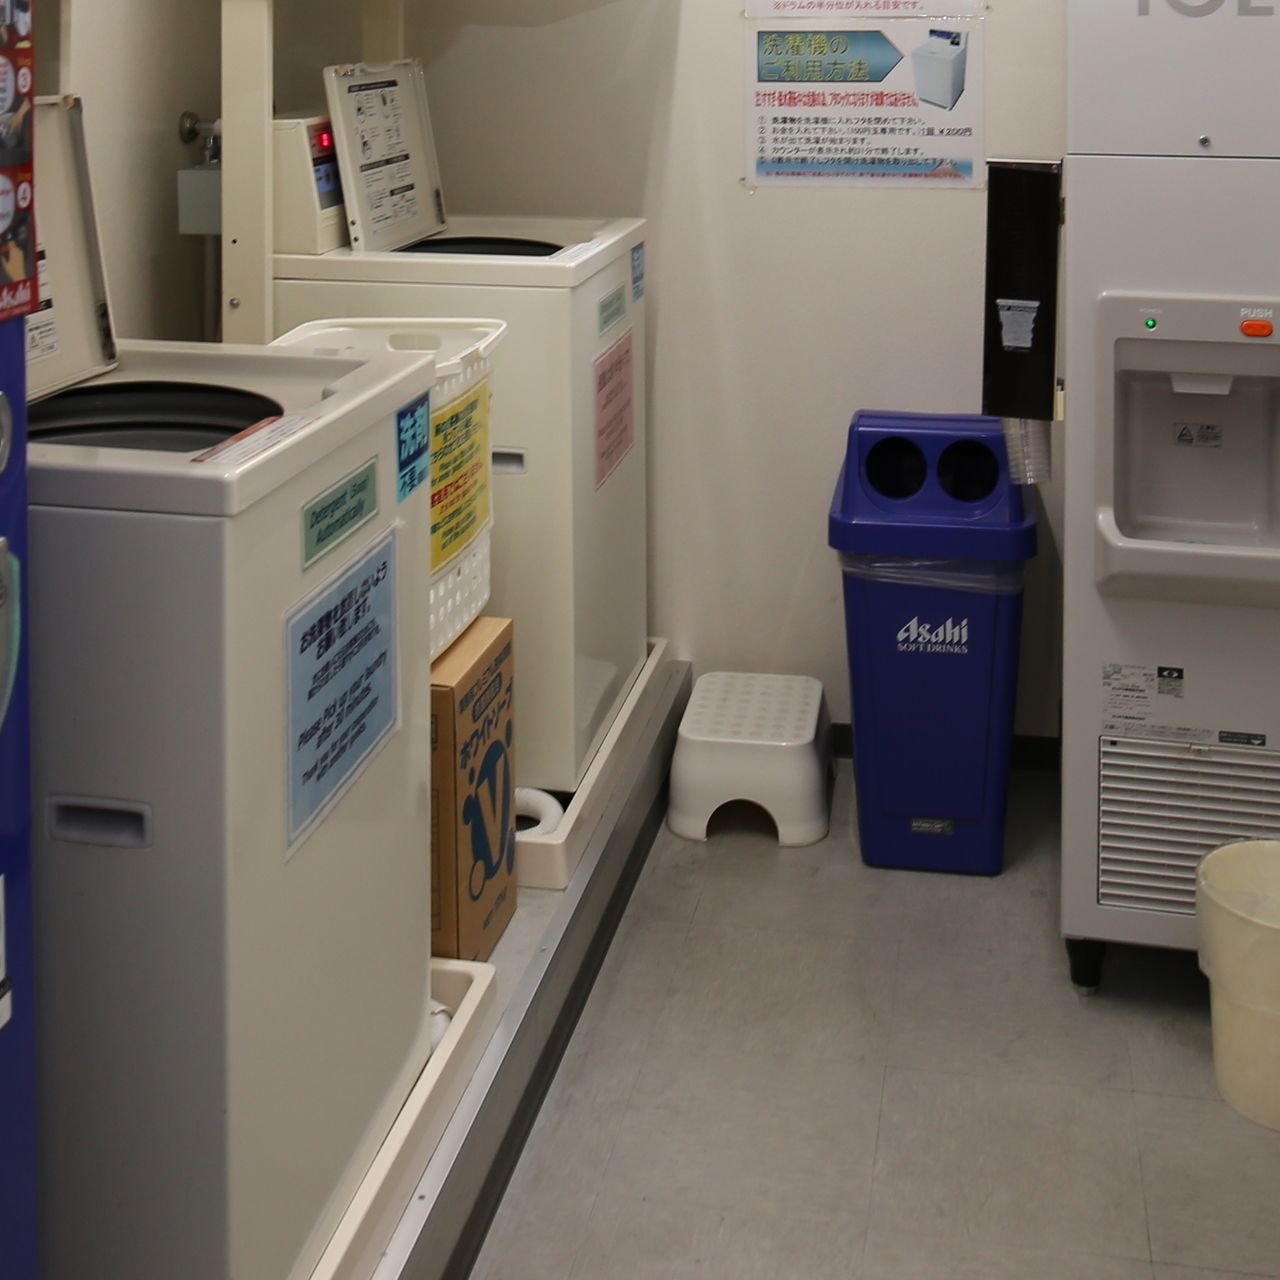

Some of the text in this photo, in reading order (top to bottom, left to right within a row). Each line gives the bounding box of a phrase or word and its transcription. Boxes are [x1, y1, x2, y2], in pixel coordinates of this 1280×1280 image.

[763, 35, 849, 56] 洗濯機の
[764, 59, 869, 81] ご利用方法
[1240, 307, 1274, 318] PUSH
[896, 615, 968, 645] Asahi
[927, 643, 969, 654] DRINKS
